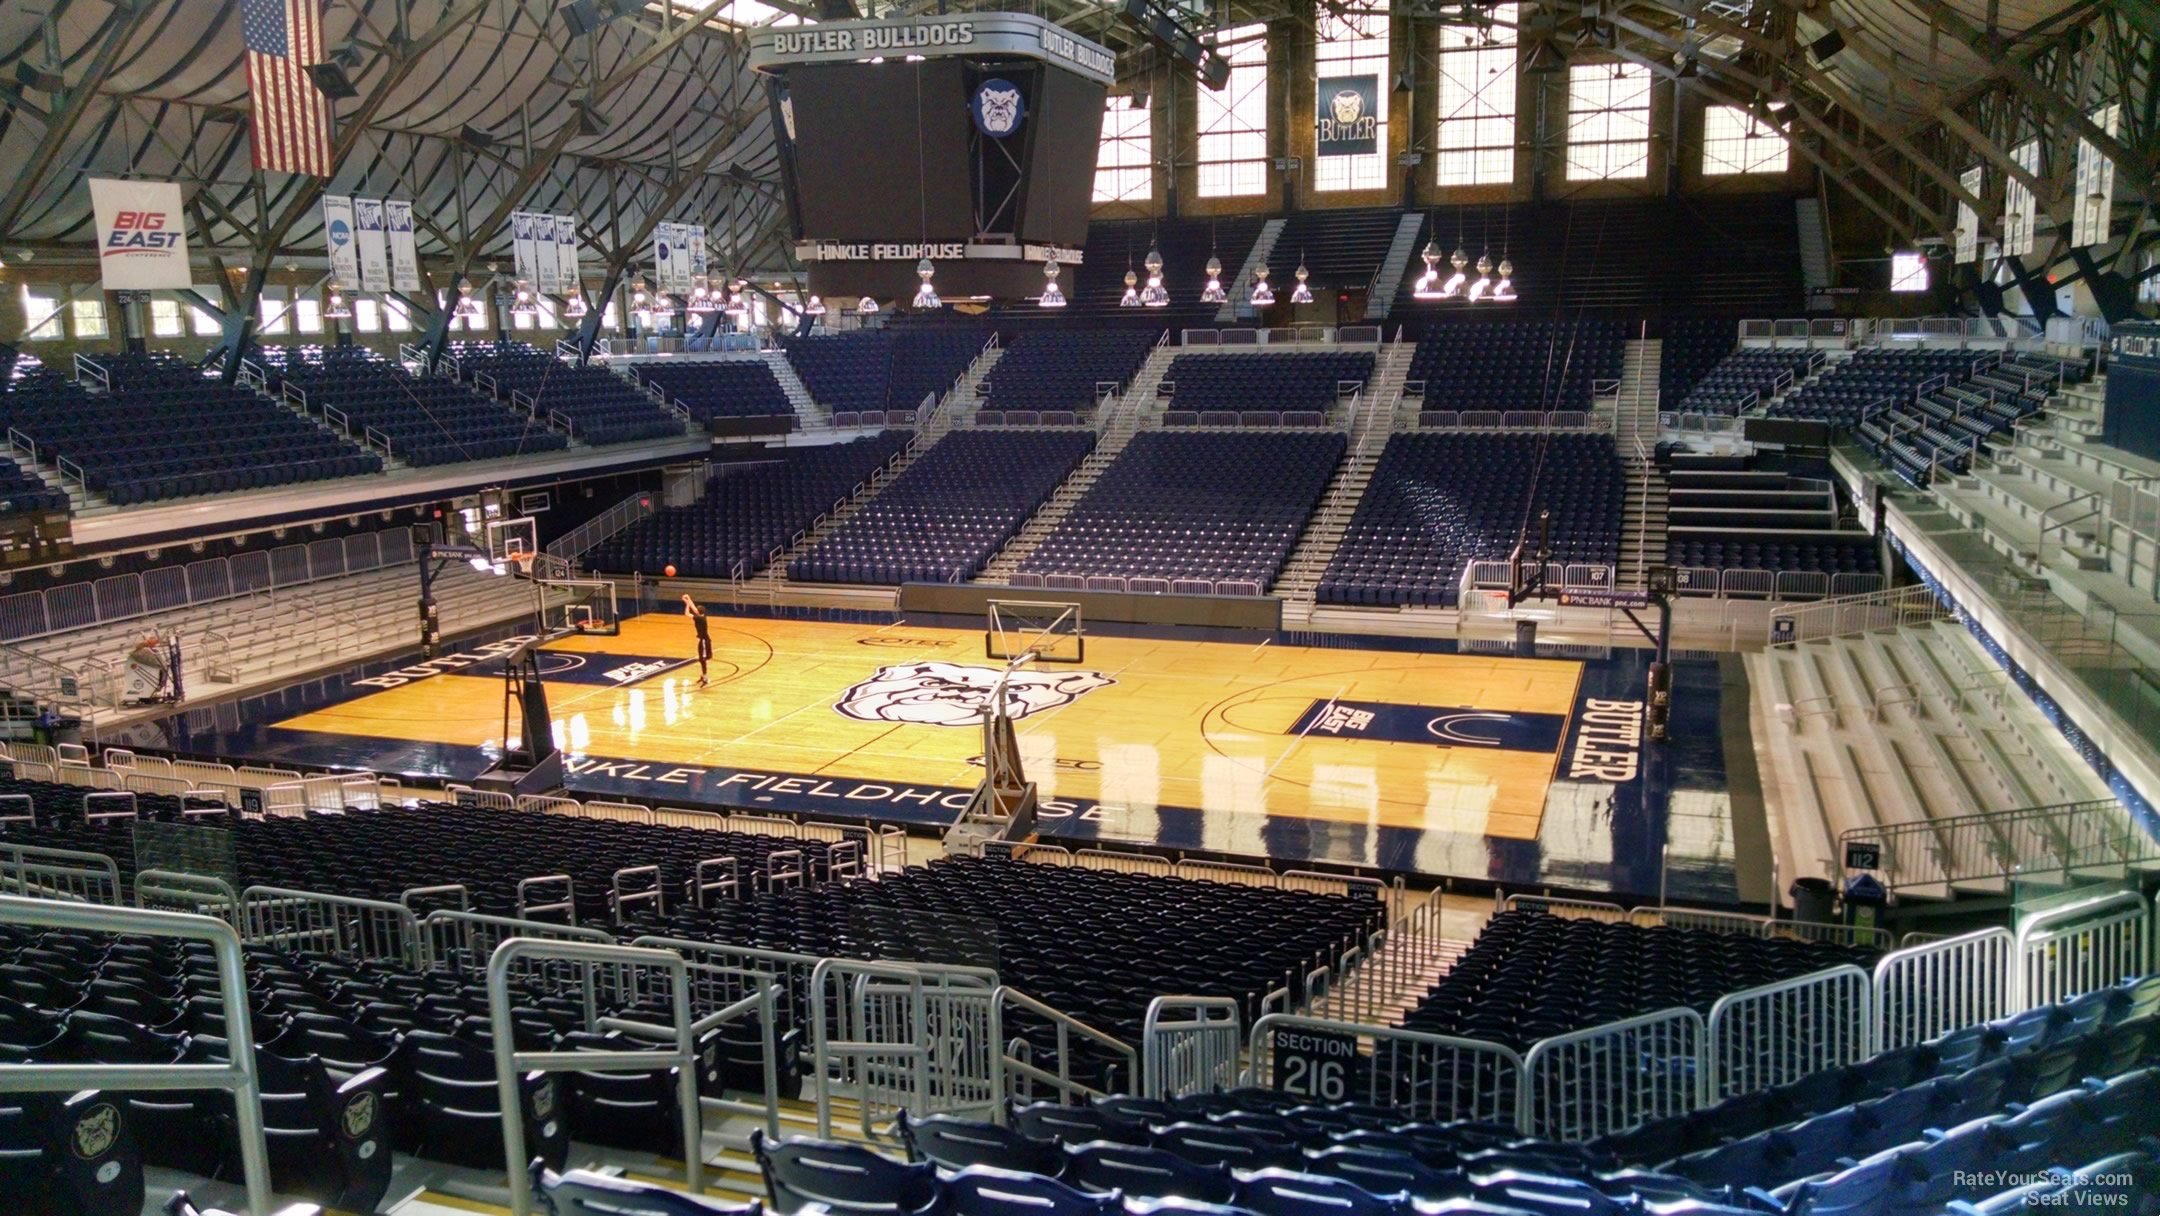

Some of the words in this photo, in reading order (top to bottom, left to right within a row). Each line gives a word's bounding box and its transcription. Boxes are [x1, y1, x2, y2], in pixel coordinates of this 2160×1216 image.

[774, 31, 854, 54] BUTLER
[864, 23, 973, 49] BULLDOGS
[1043, 29, 1075, 60] BUTLER
[1319, 116, 1376, 142] BUTLER
[113, 211, 166, 230] BIG
[107, 231, 181, 248] EAST
[817, 244, 869, 260] HINKLE
[871, 243, 963, 260] FIELDHOUSE
[1320, 706, 1356, 734] EAST
[1345, 709, 1376, 731] BIG
[1570, 698, 1643, 781] BUTLER
[245, 798, 259, 811] 119
[844, 831, 867, 839] SECTION
[985, 845, 1011, 854] SECTION
[1852, 853, 1873, 868] 112
[1277, 1032, 1353, 1058] SECTION
[1283, 1055, 1345, 1100] 216
